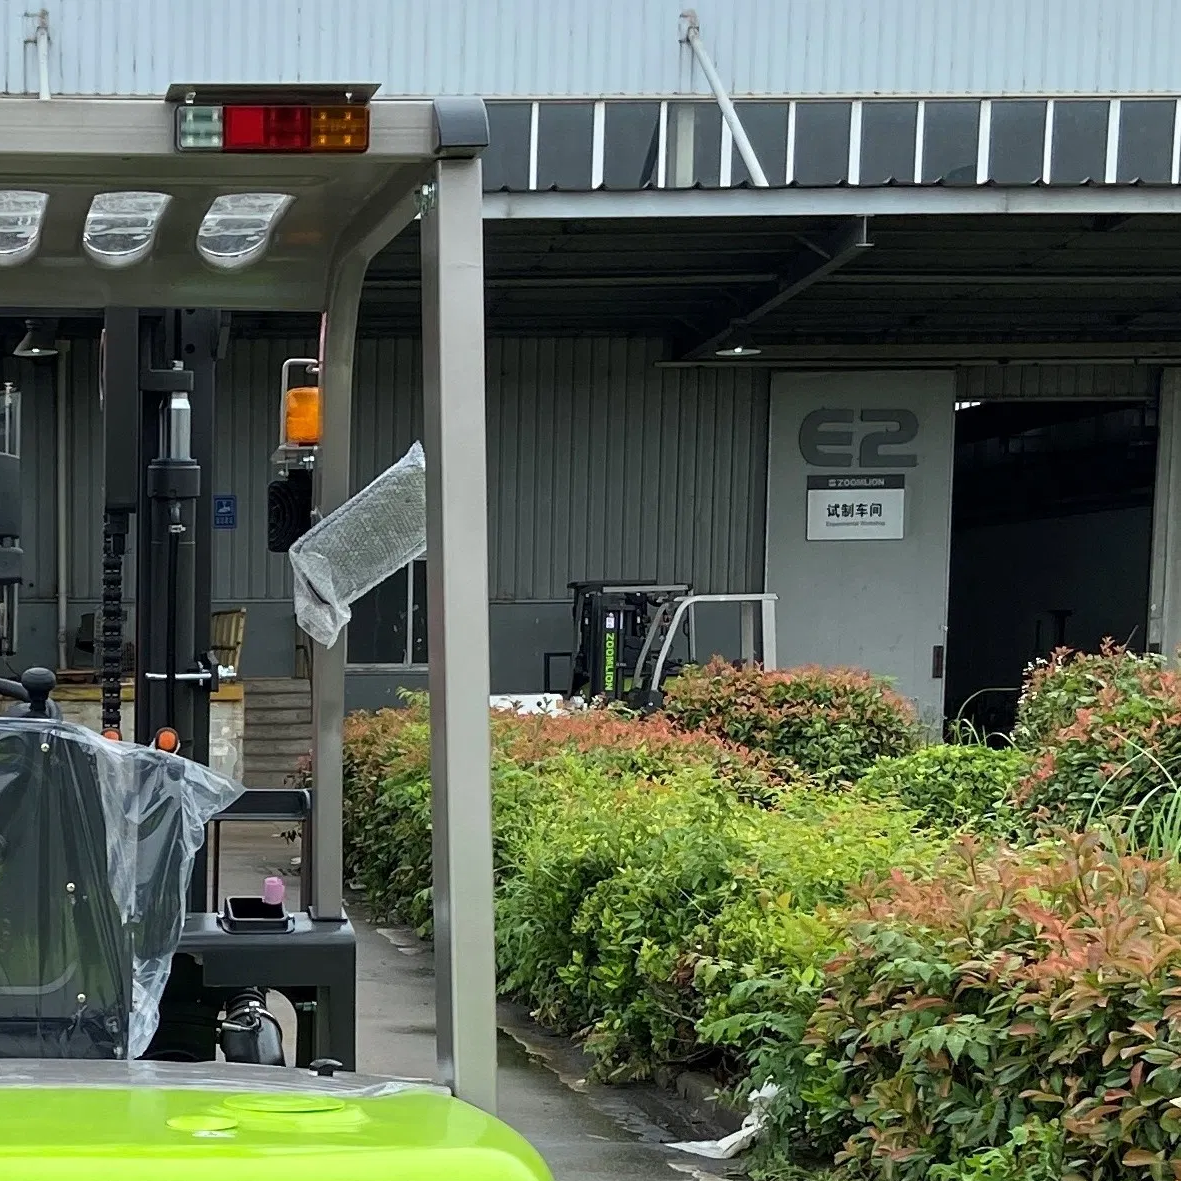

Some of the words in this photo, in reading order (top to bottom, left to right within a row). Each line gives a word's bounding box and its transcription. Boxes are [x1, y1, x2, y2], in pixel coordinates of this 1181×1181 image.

[799, 407, 919, 467] E2
[837, 478, 885, 488] ZOOMLION
[827, 502, 883, 518] 试制车间
[605, 632, 615, 691] ZOOMLION
